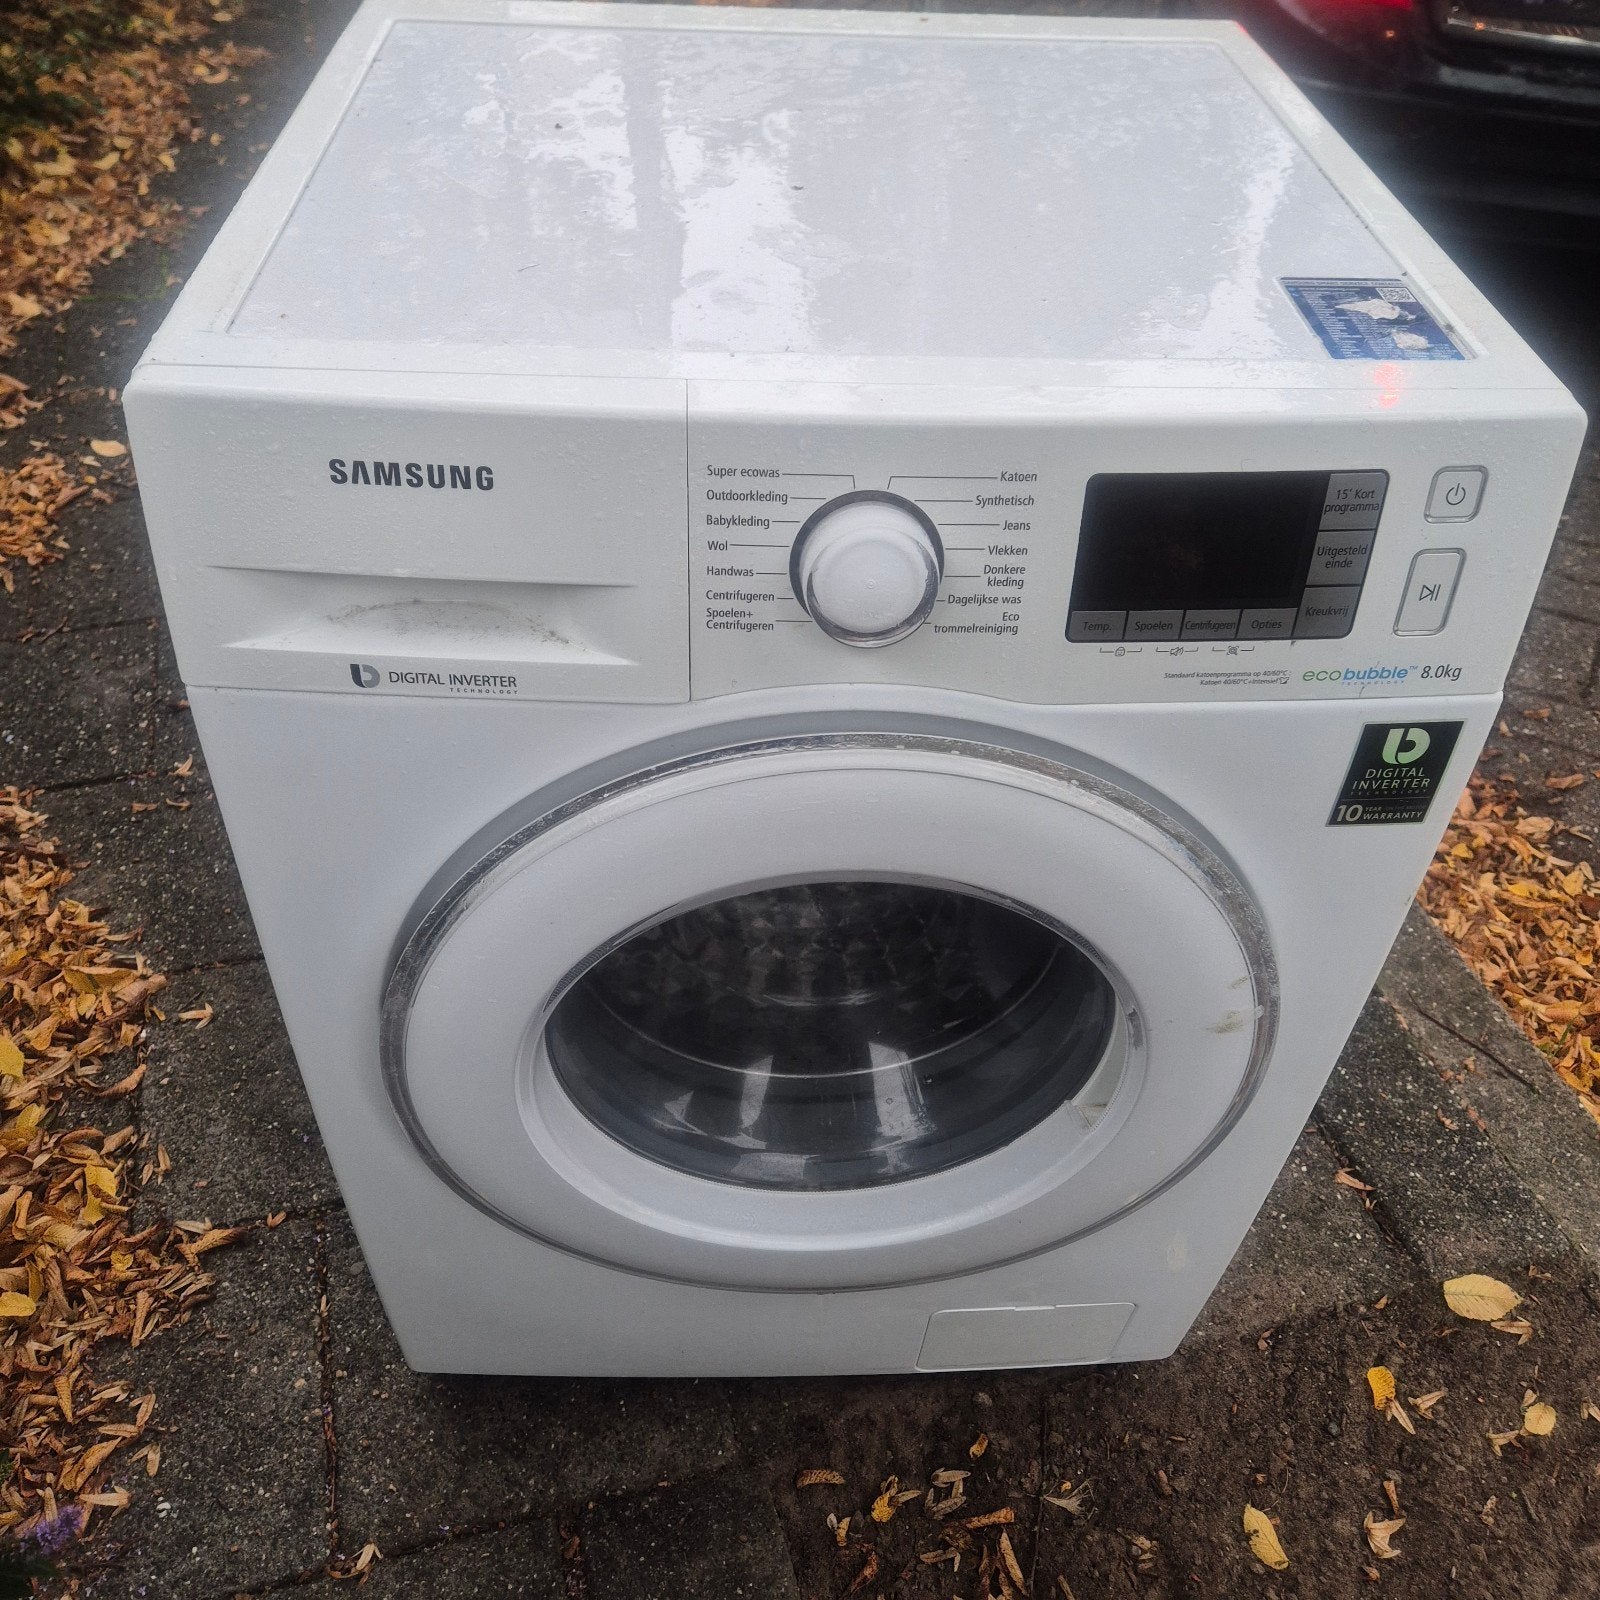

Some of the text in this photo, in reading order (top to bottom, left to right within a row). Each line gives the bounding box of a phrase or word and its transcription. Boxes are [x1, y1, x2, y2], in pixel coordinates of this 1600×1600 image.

[328, 458, 494, 491] SAMSUNG
[706, 465, 781, 479] Super ecowas
[1000, 471, 1038, 482] Katoen
[706, 489, 789, 505] Outdoorkleding
[1355, 489, 1375, 499] Kort
[975, 495, 1035, 508] Synthetisch
[1324, 502, 1380, 515] programma
[706, 515, 771, 530] Babykleding
[1003, 520, 1031, 531] Jeans
[707, 540, 729, 551] Wol
[988, 545, 1029, 556] Vlekken
[1317, 544, 1368, 558] Uitgesteld
[1325, 558, 1353, 569] einde
[706, 566, 754, 577] Handwas
[983, 565, 1026, 575] Donkere
[987, 577, 1025, 590] kleding
[706, 590, 775, 604] Centrifugeren
[948, 594, 1022, 607] Dagelijkse was
[706, 608, 754, 621] Spoelen+
[1002, 612, 1020, 622] Eco
[1305, 606, 1349, 618] Kreukvrij
[706, 619, 775, 632] Centrifugeren
[934, 623, 1019, 635] trommelreiniging
[1083, 621, 1112, 632] Temp.
[1135, 620, 1174, 632] Spoelen
[1185, 619, 1236, 632] Centrifugeren
[1251, 619, 1283, 630] Opties
[1420, 664, 1463, 682] 8.0kg
[388, 671, 518, 688] DIGITAL INVERTER
[450, 687, 519, 695] TECHNOLOGY
[1365, 767, 1425, 779] DIGITAL
[1352, 778, 1430, 790] INVERTER
[1336, 804, 1363, 822] 10
[1363, 811, 1423, 820] WARRANTY
